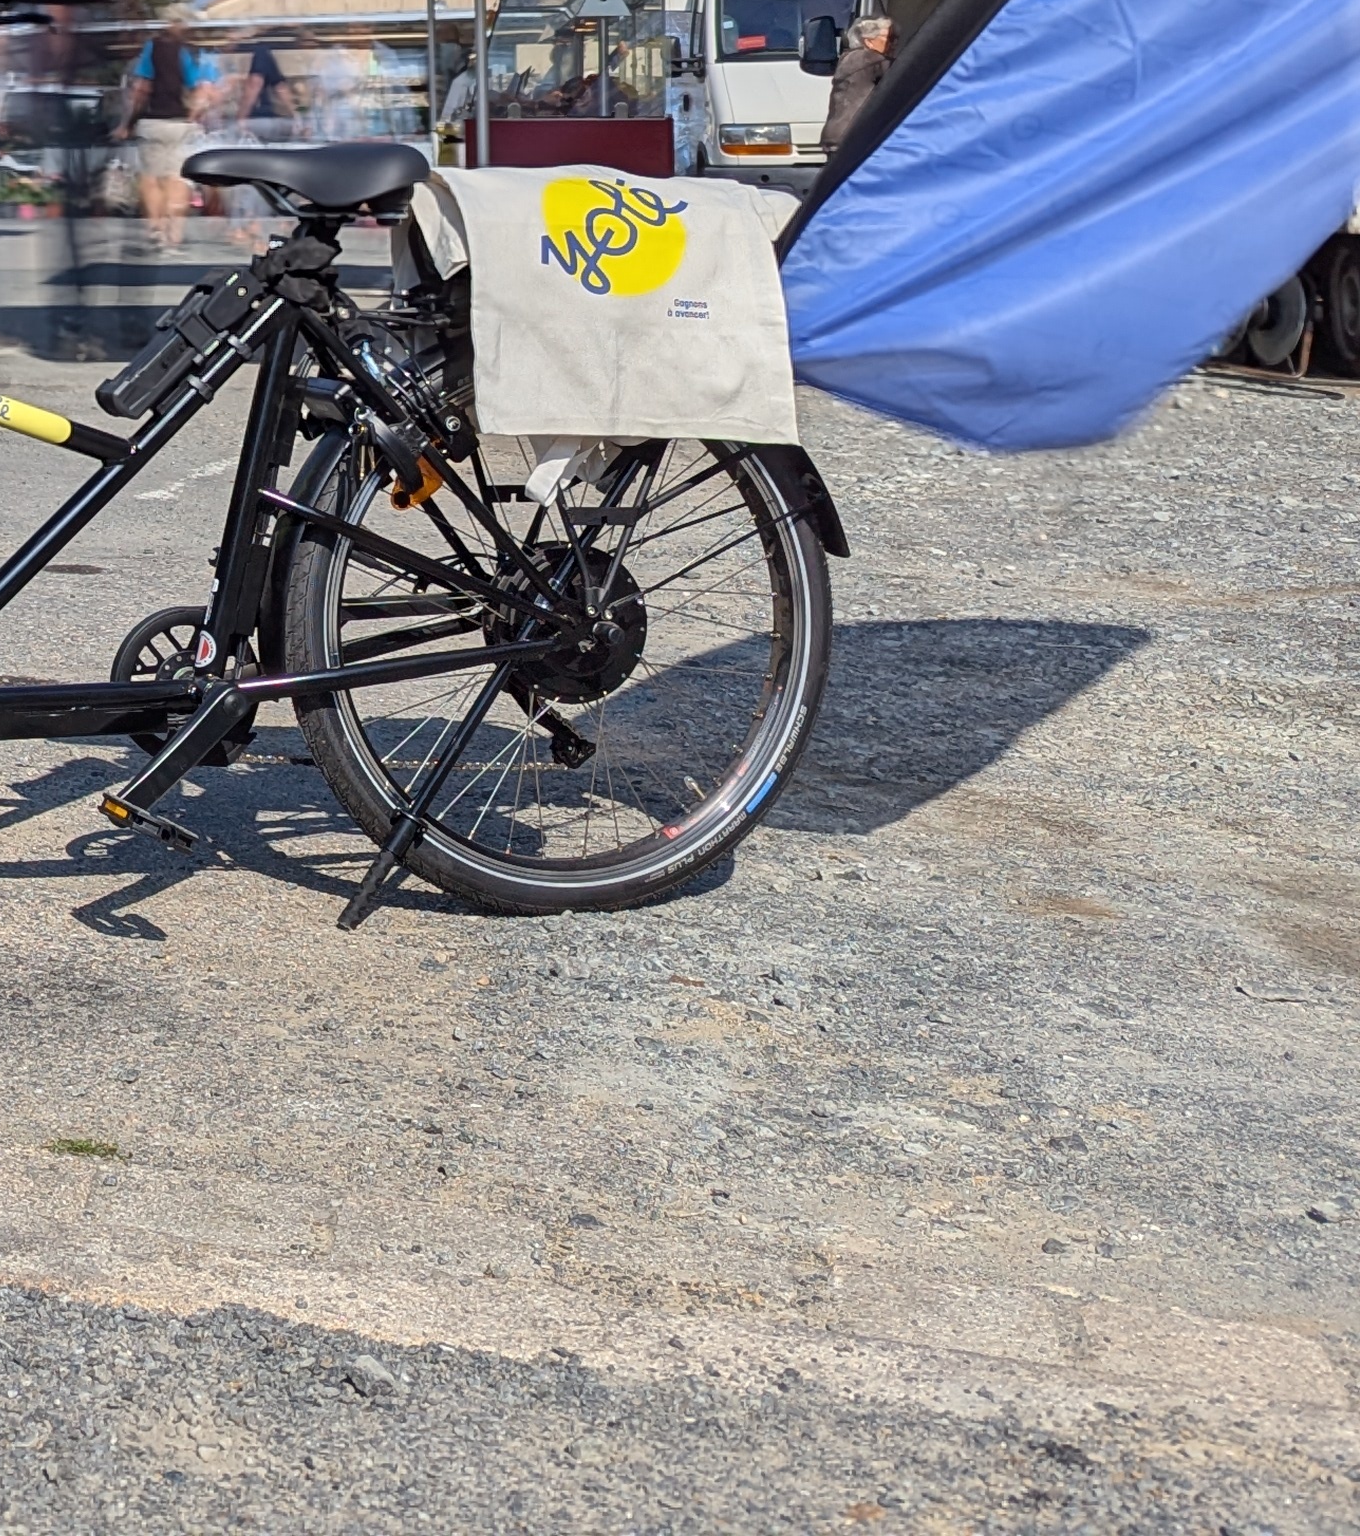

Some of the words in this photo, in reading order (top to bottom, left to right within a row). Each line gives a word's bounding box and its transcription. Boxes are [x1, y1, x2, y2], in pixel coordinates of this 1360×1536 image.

[674, 299, 708, 310] Gagnons
[775, 704, 808, 773] SCHWALBE
[697, 810, 748, 857] MARATHON
[667, 855, 695, 875] PLUS
